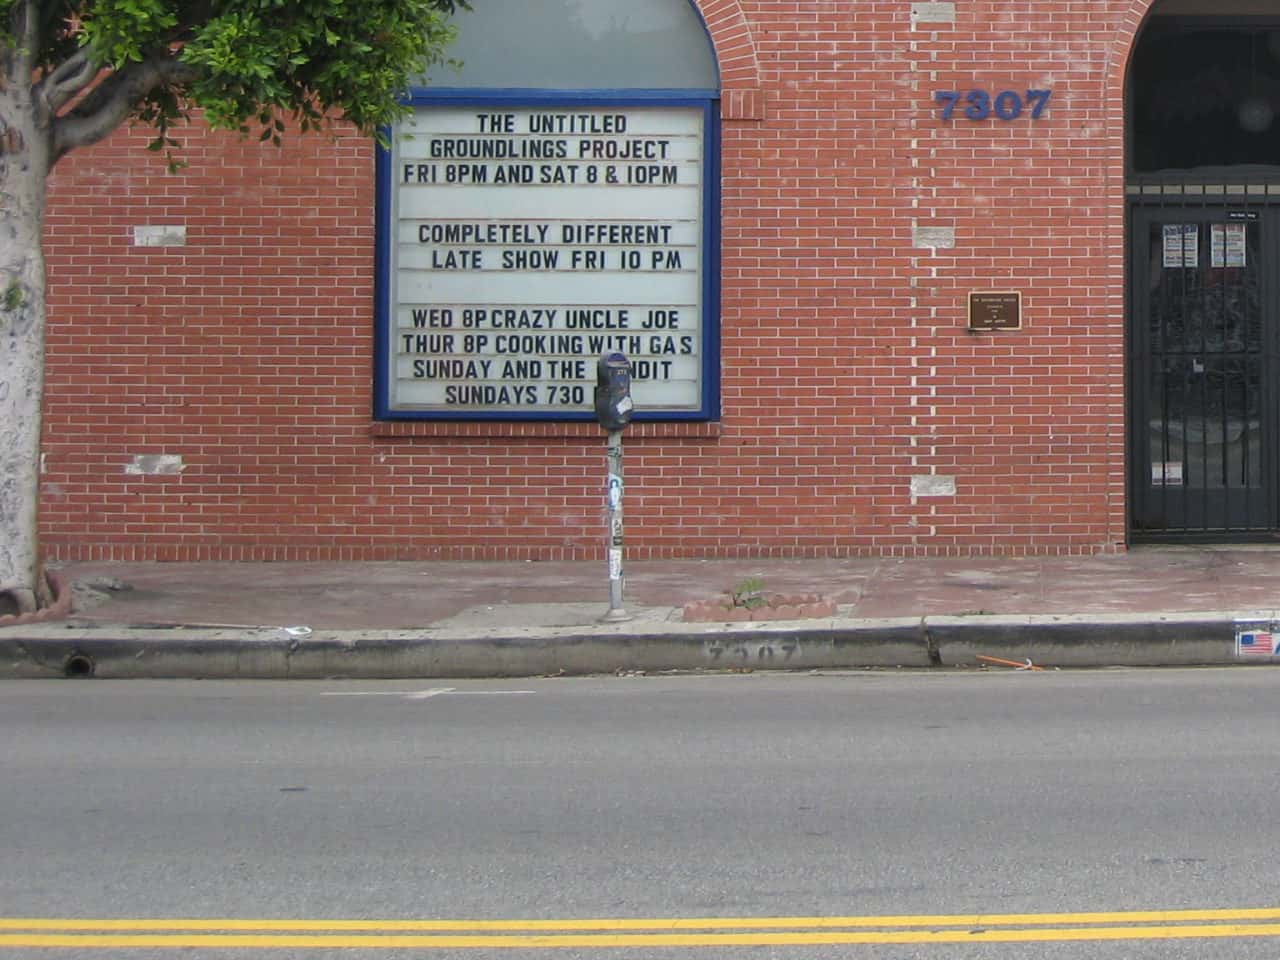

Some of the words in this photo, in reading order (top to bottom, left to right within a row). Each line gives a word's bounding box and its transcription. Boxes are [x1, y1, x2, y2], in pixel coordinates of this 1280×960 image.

[935, 89, 1053, 121] 7307
[475, 113, 515, 136] THE
[529, 113, 627, 136] UNTITLED
[430, 138, 567, 161] GROUNDLINGS
[579, 139, 670, 160] PROJECT
[401, 163, 437, 186] FRI
[445, 164, 487, 186] 8PM
[493, 164, 534, 186] AND
[540, 164, 579, 184] SAT
[586, 165, 598, 184] 8
[605, 165, 619, 184] &
[627, 165, 678, 185] 10PM
[418, 223, 549, 246] COMPLETELY
[562, 224, 672, 244] DIFFERENT
[431, 249, 482, 270] LATE
[502, 250, 559, 270] SHOW
[571, 250, 605, 270] FRI
[620, 250, 641, 270] 10
[651, 250, 682, 270] PM
[411, 308, 453, 330] WED
[462, 309, 487, 329] 8P
[491, 309, 557, 331] CRAZY
[565, 309, 629, 329] UNCLE
[641, 310, 679, 330] JOE
[402, 333, 455, 354] THUR
[463, 334, 489, 354] 8P
[495, 334, 583, 355] COOKING
[588, 335, 641, 356] WITH
[649, 335, 692, 357] GAS
[412, 359, 492, 381] SUNDAY
[501, 359, 542, 380] AND
[546, 360, 585, 380] THE
[444, 385, 538, 406] SUNDAYS
[546, 385, 585, 406] 730
